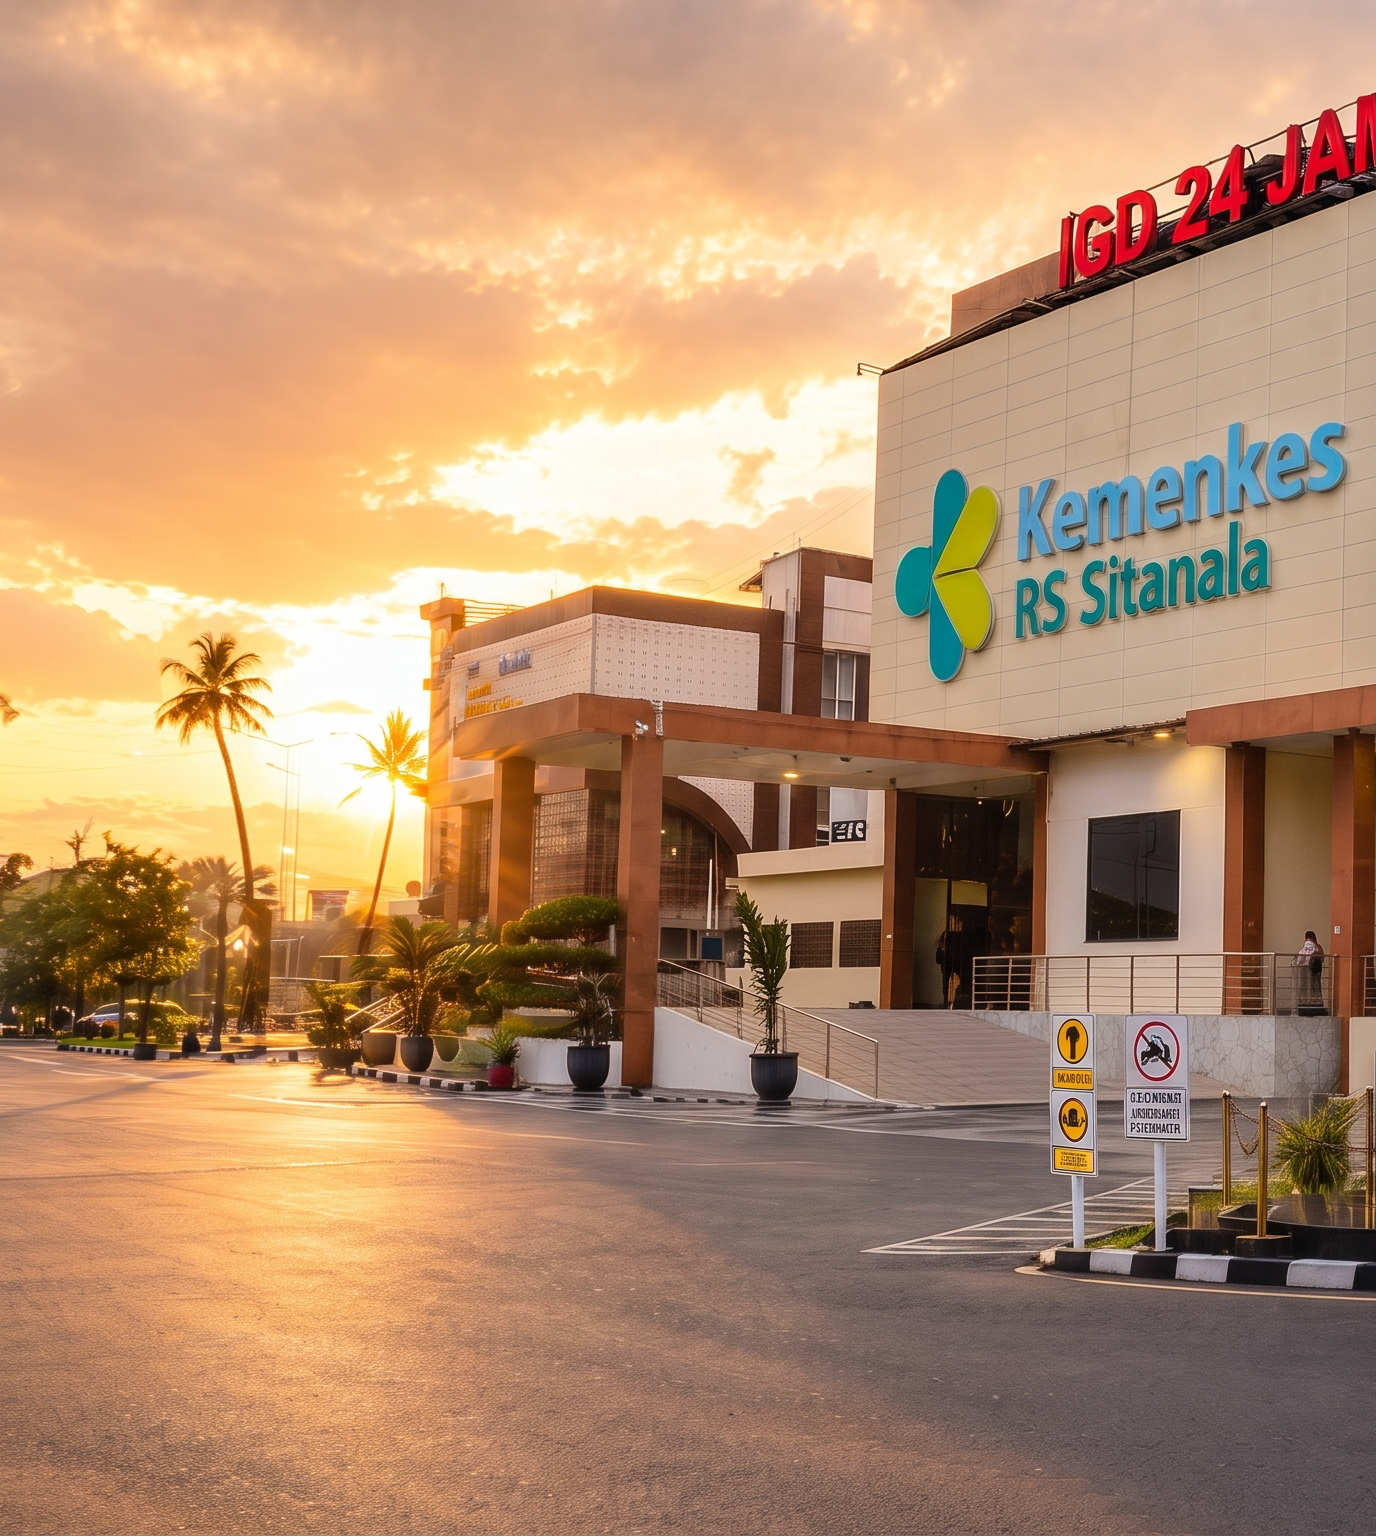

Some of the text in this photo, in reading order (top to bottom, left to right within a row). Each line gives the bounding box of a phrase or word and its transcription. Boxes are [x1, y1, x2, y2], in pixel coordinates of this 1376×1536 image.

[1059, 190, 1158, 289] IGD
[1172, 144, 1249, 245] 24
[1017, 421, 1346, 562] Kemenkes
[1015, 520, 1272, 639] RS Sitanala
